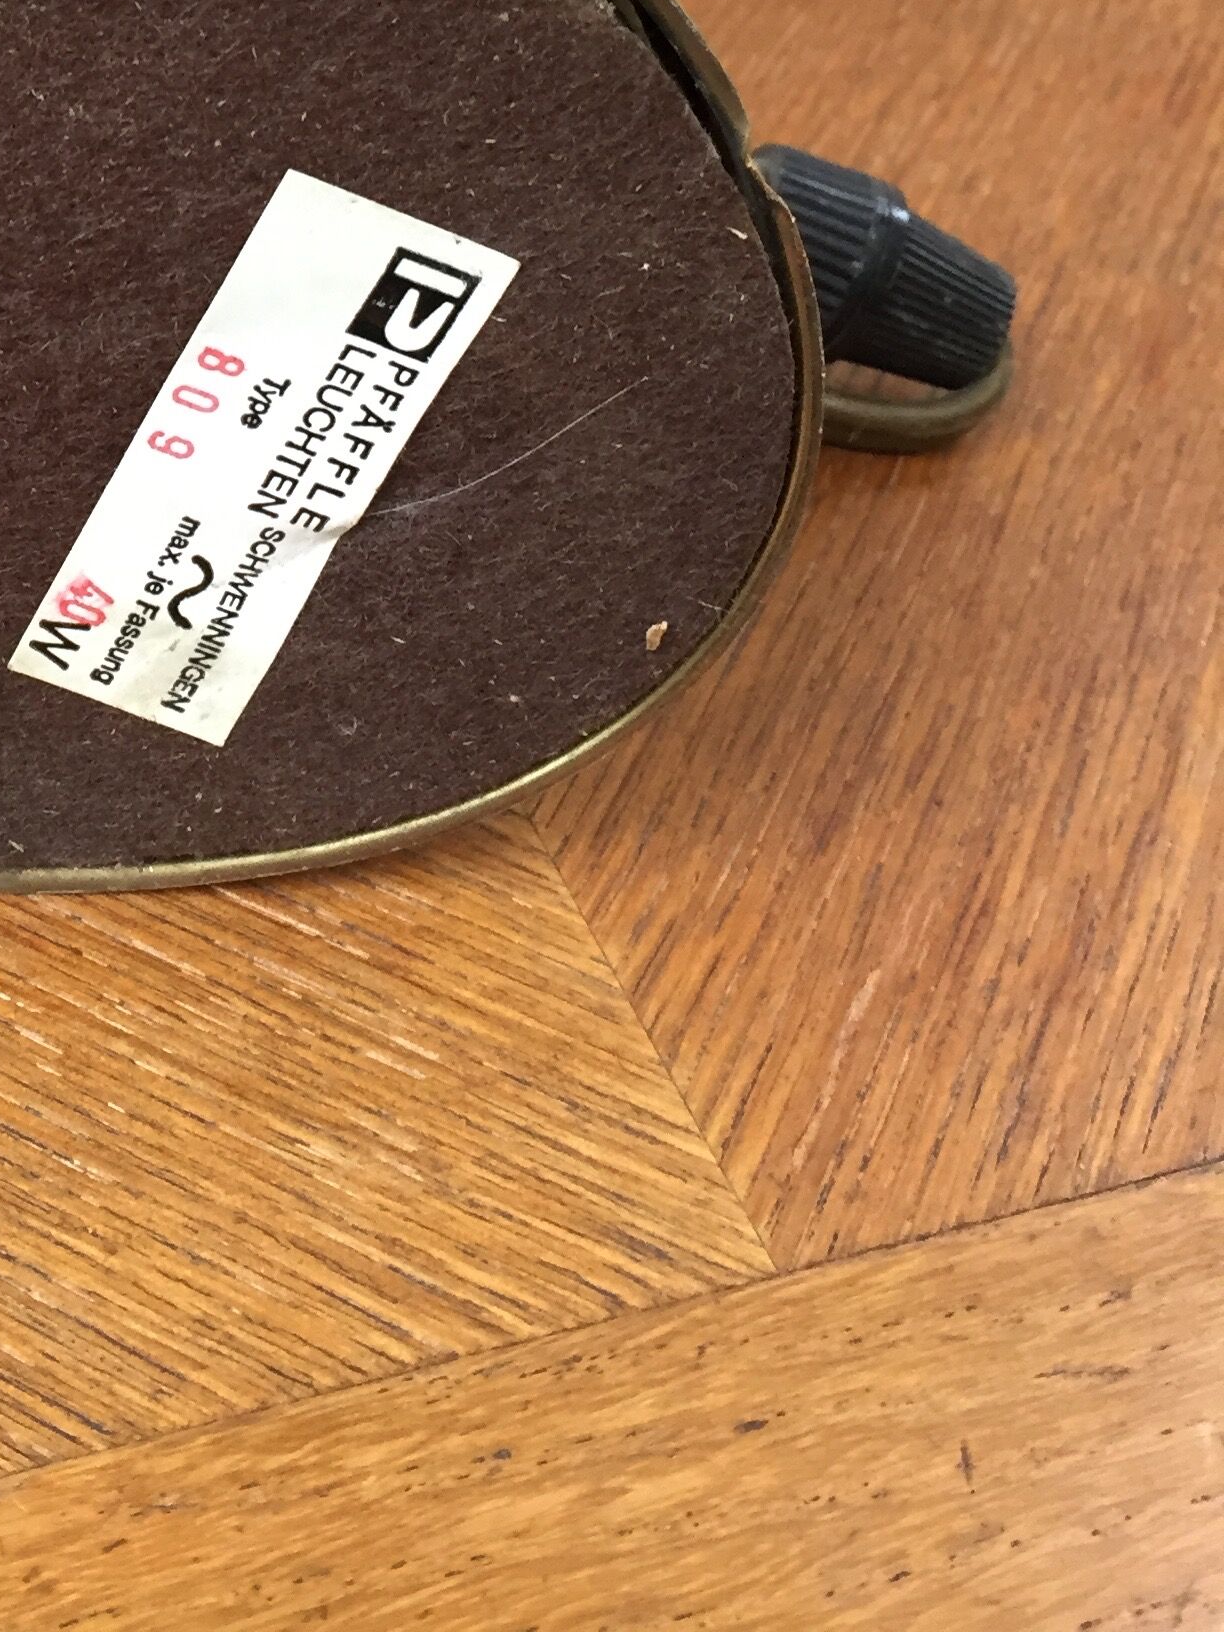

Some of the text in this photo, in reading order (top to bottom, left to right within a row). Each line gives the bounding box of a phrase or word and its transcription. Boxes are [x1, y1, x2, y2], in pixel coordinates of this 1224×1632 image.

[240, 377, 292, 430] Type
[289, 360, 420, 533] PFÄFFLE
[89, 515, 201, 686] max. je Fassung
[160, 343, 378, 713] LEUCHTEN SCHWENNINGEN
